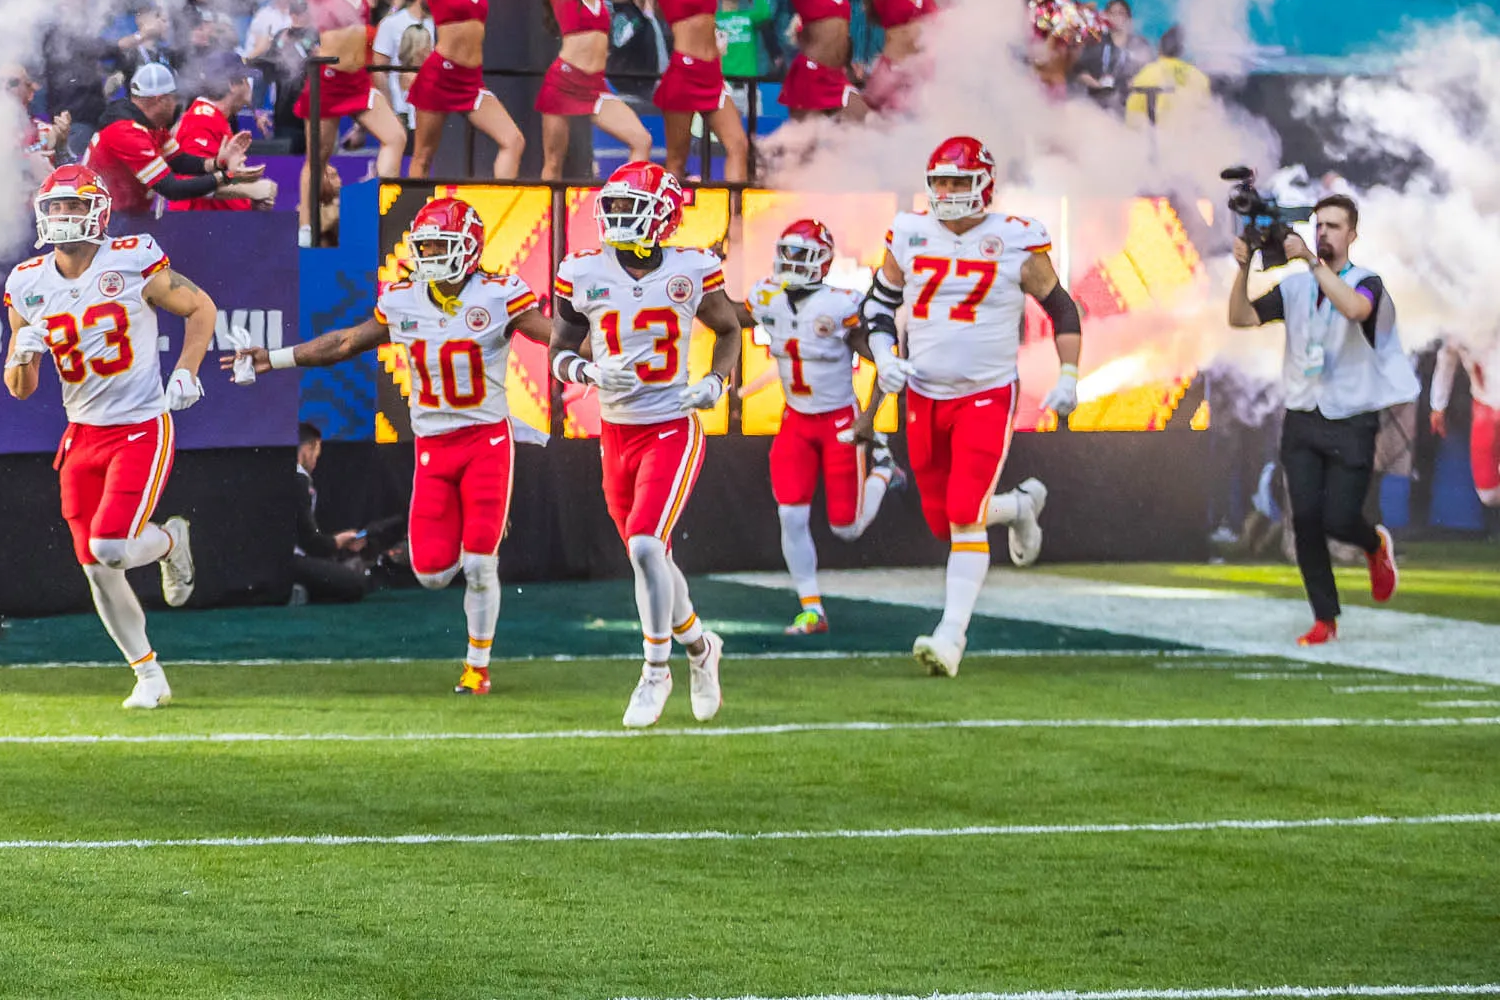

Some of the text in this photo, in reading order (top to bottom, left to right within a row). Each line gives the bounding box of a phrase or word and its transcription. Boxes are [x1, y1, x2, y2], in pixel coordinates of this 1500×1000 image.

[912, 255, 998, 323] 77
[41, 301, 135, 384] 83
[185, 309, 283, 352] VII
[599, 306, 682, 385] 13
[409, 338, 487, 410] 10
[784, 337, 813, 396] 1
